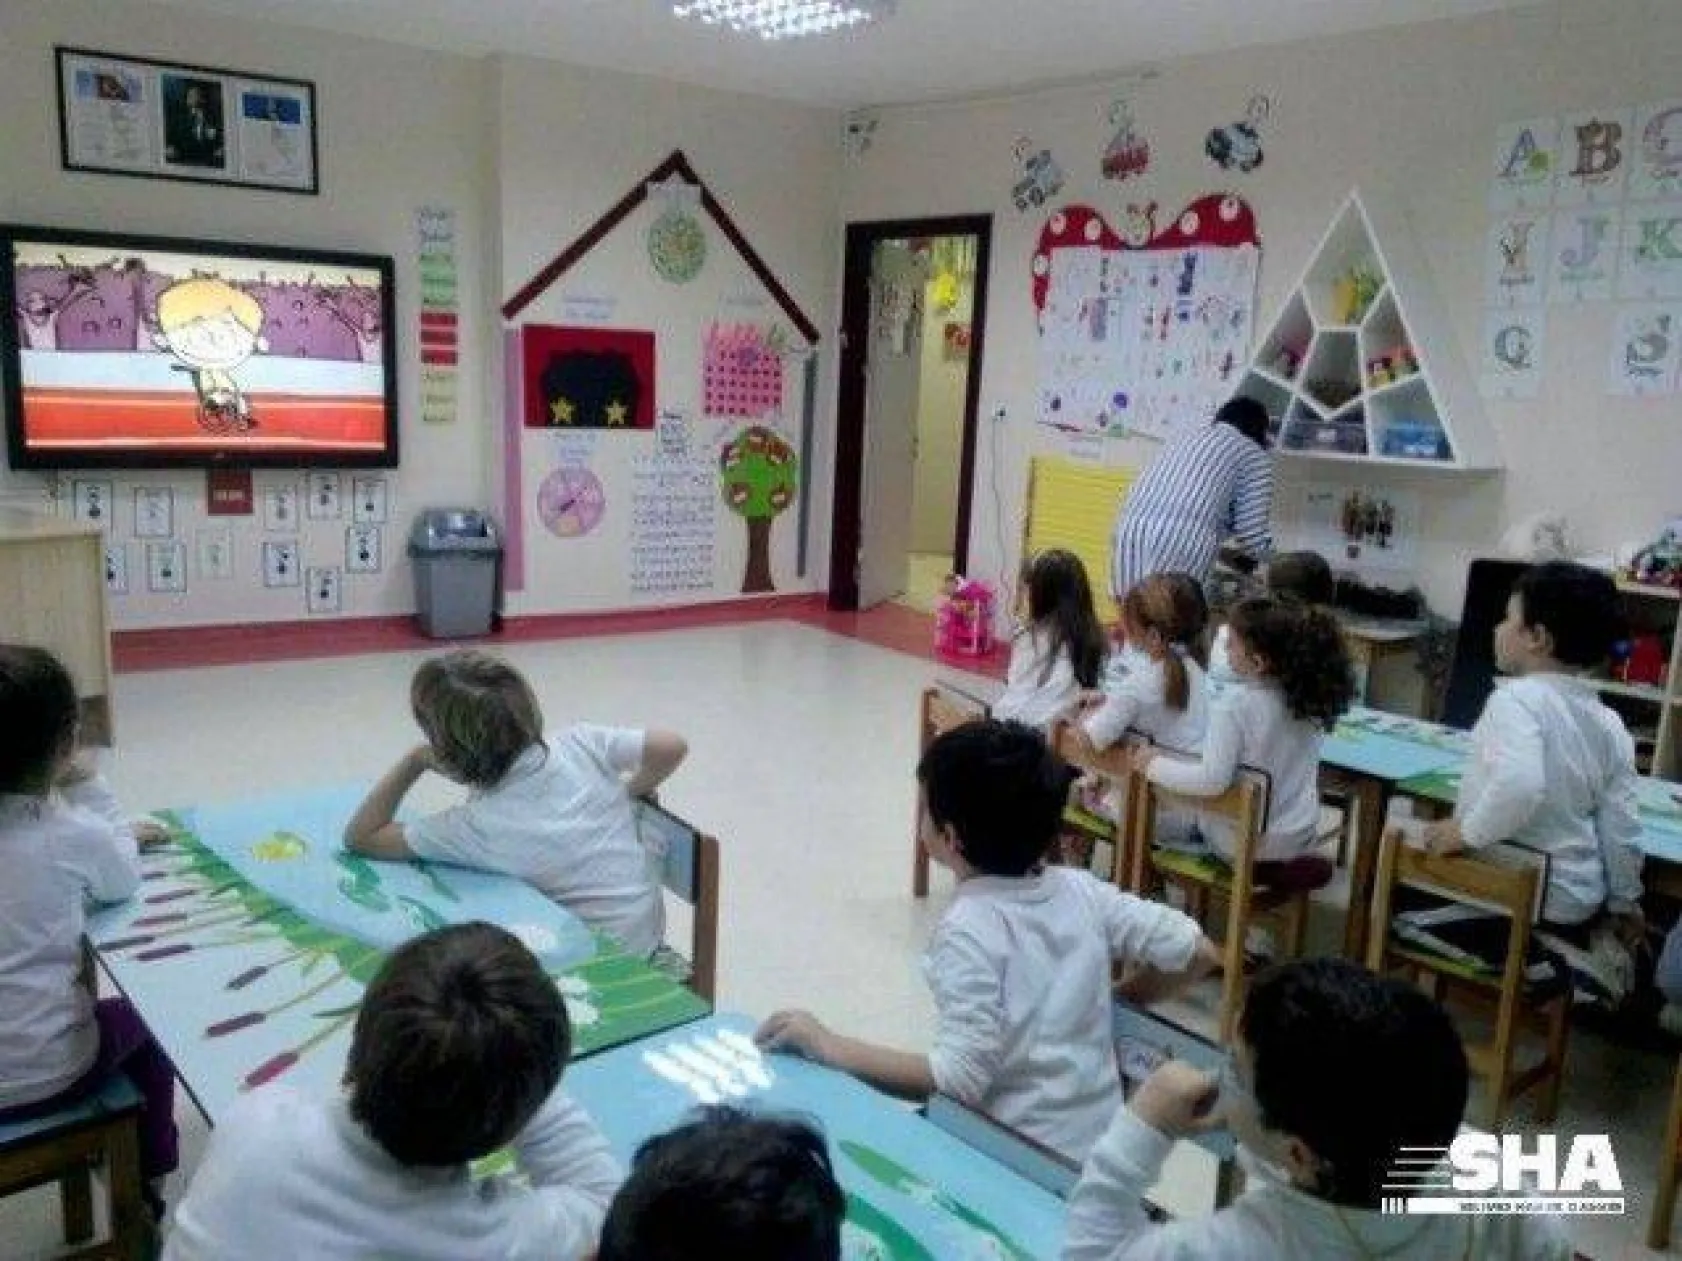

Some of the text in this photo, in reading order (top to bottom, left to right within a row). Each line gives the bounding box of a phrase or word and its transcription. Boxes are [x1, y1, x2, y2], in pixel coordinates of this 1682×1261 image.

[1498, 128, 1548, 178] A
[1569, 118, 1622, 177] B
[1558, 216, 1608, 270] J
